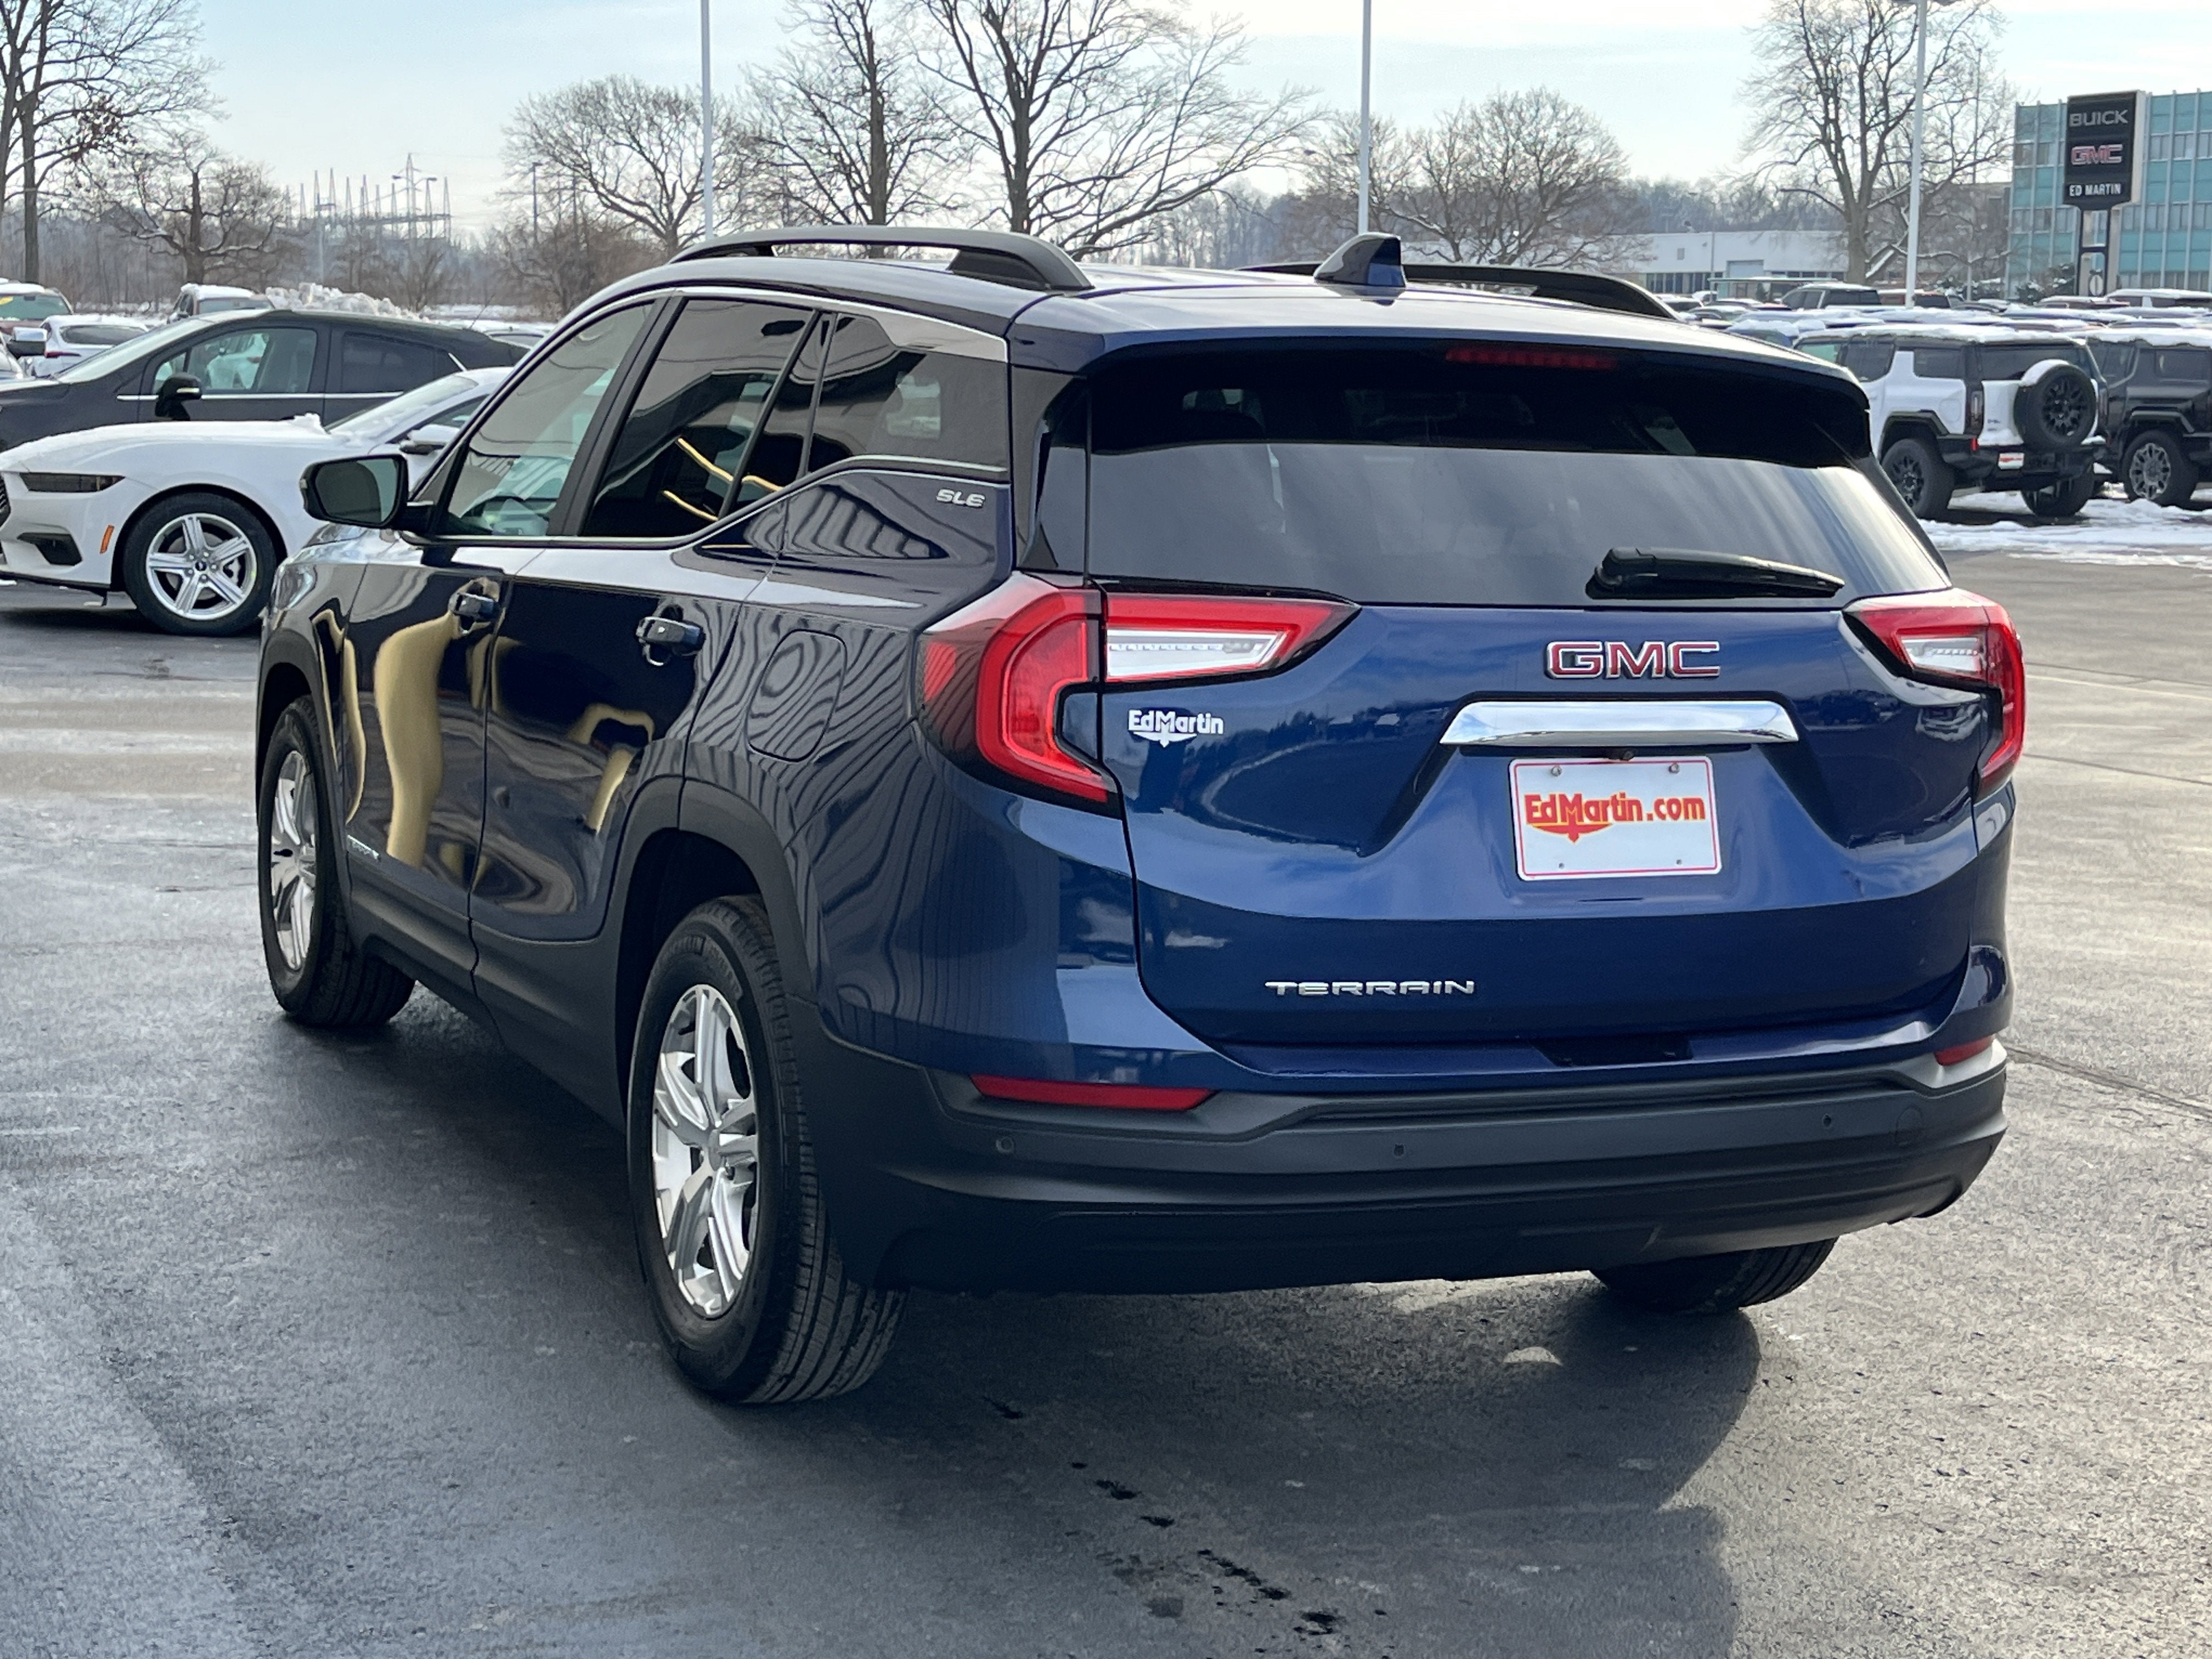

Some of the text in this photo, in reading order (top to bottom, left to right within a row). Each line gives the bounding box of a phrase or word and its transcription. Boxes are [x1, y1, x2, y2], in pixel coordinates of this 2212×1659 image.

[2069, 110, 2128, 127] BUICK
[2071, 144, 2123, 165] GMC
[2069, 183, 2121, 196] ED MARTIN
[936, 488, 985, 507] SLE
[1547, 641, 1720, 679] GMC
[1128, 709, 1224, 735] EdMartin
[1524, 792, 1706, 824] EdMartin.com
[1265, 980, 1475, 996] TERRAIN
